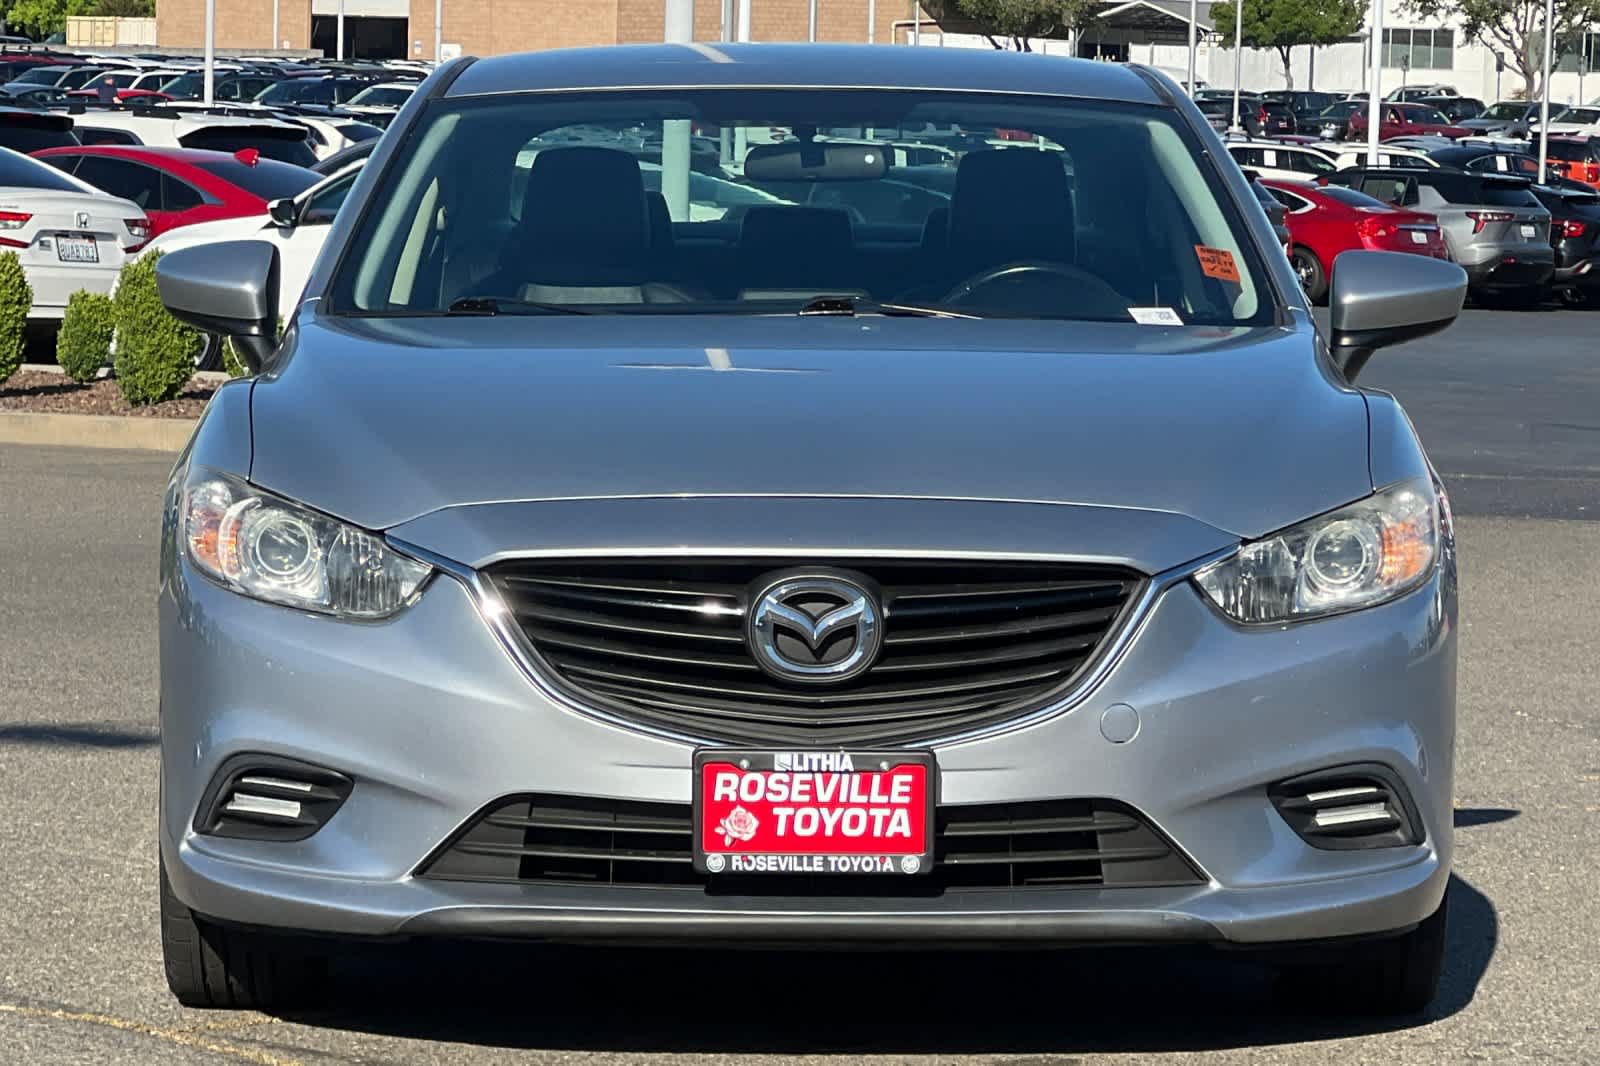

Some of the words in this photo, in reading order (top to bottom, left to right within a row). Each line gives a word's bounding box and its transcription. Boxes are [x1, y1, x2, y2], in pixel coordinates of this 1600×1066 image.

[793, 752, 855, 772] LITHIA
[713, 772, 913, 804] ROSEVILLE
[772, 806, 912, 838] TOYOTA
[731, 856, 826, 872] ROSEVILLE
[827, 857, 895, 873] TOYOTA
